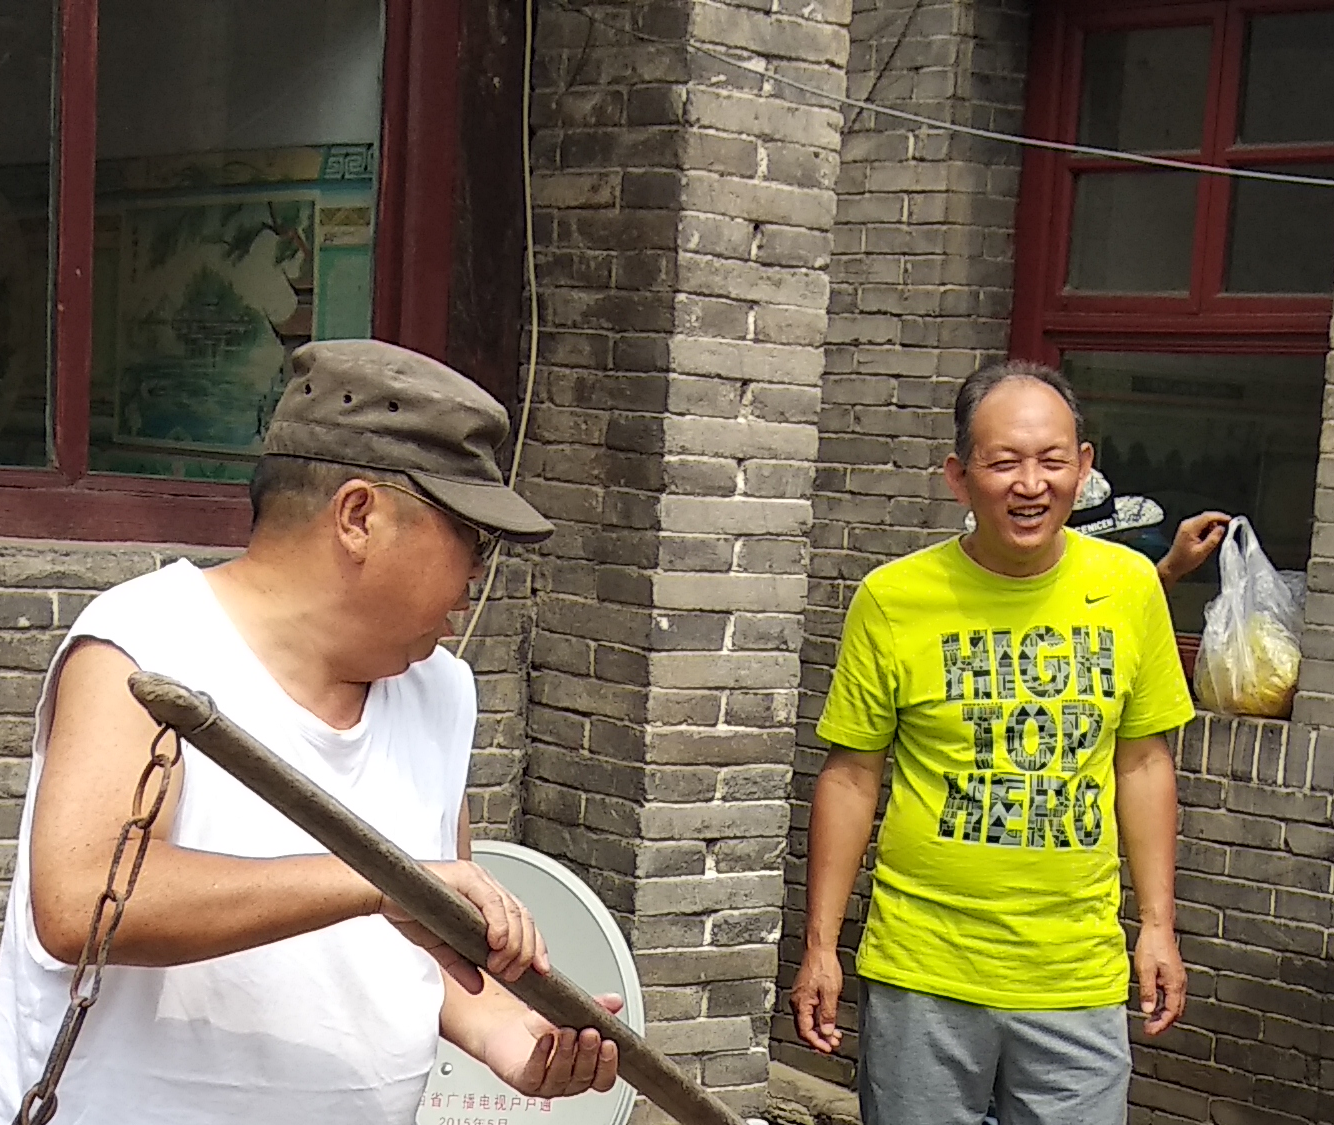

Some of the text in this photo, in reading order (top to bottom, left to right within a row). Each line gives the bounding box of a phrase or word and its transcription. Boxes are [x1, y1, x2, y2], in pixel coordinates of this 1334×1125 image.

[940, 624, 1117, 701] HIGH
[961, 699, 1104, 774] TOP
[937, 771, 1104, 849] HERO
